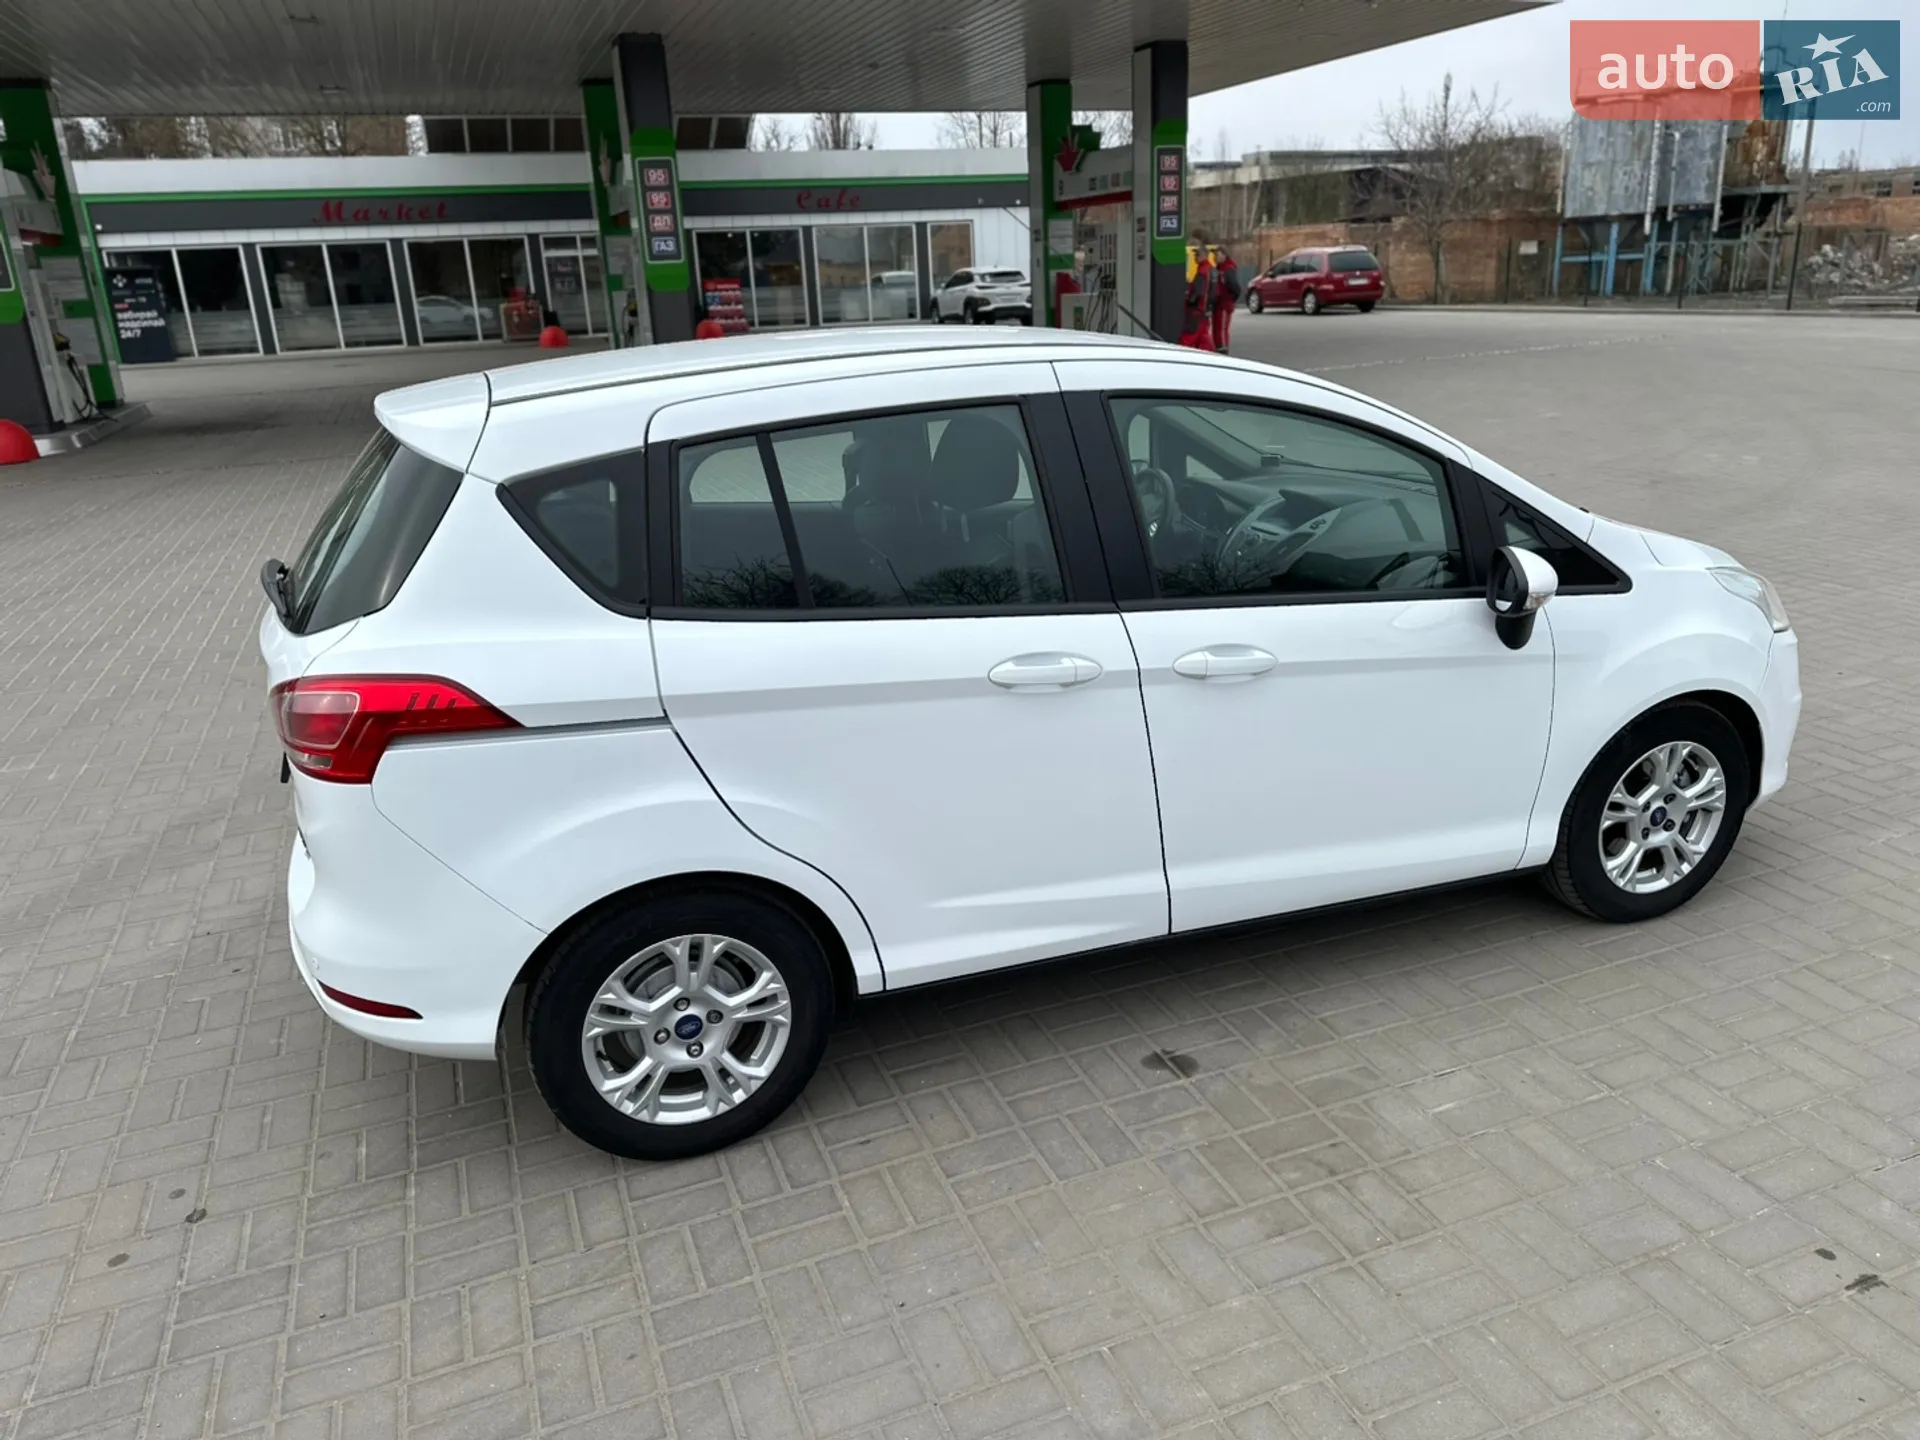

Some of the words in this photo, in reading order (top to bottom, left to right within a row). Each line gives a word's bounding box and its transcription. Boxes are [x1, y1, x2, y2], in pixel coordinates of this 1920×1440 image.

[648, 169, 665, 181] 95
[650, 192, 667, 204] 95
[796, 187, 861, 212] Cafe
[311, 199, 450, 224] Market
[653, 215, 671, 227] ДП
[654, 240, 674, 251] ГАЗ
[120, 329, 141, 339] 24/7
